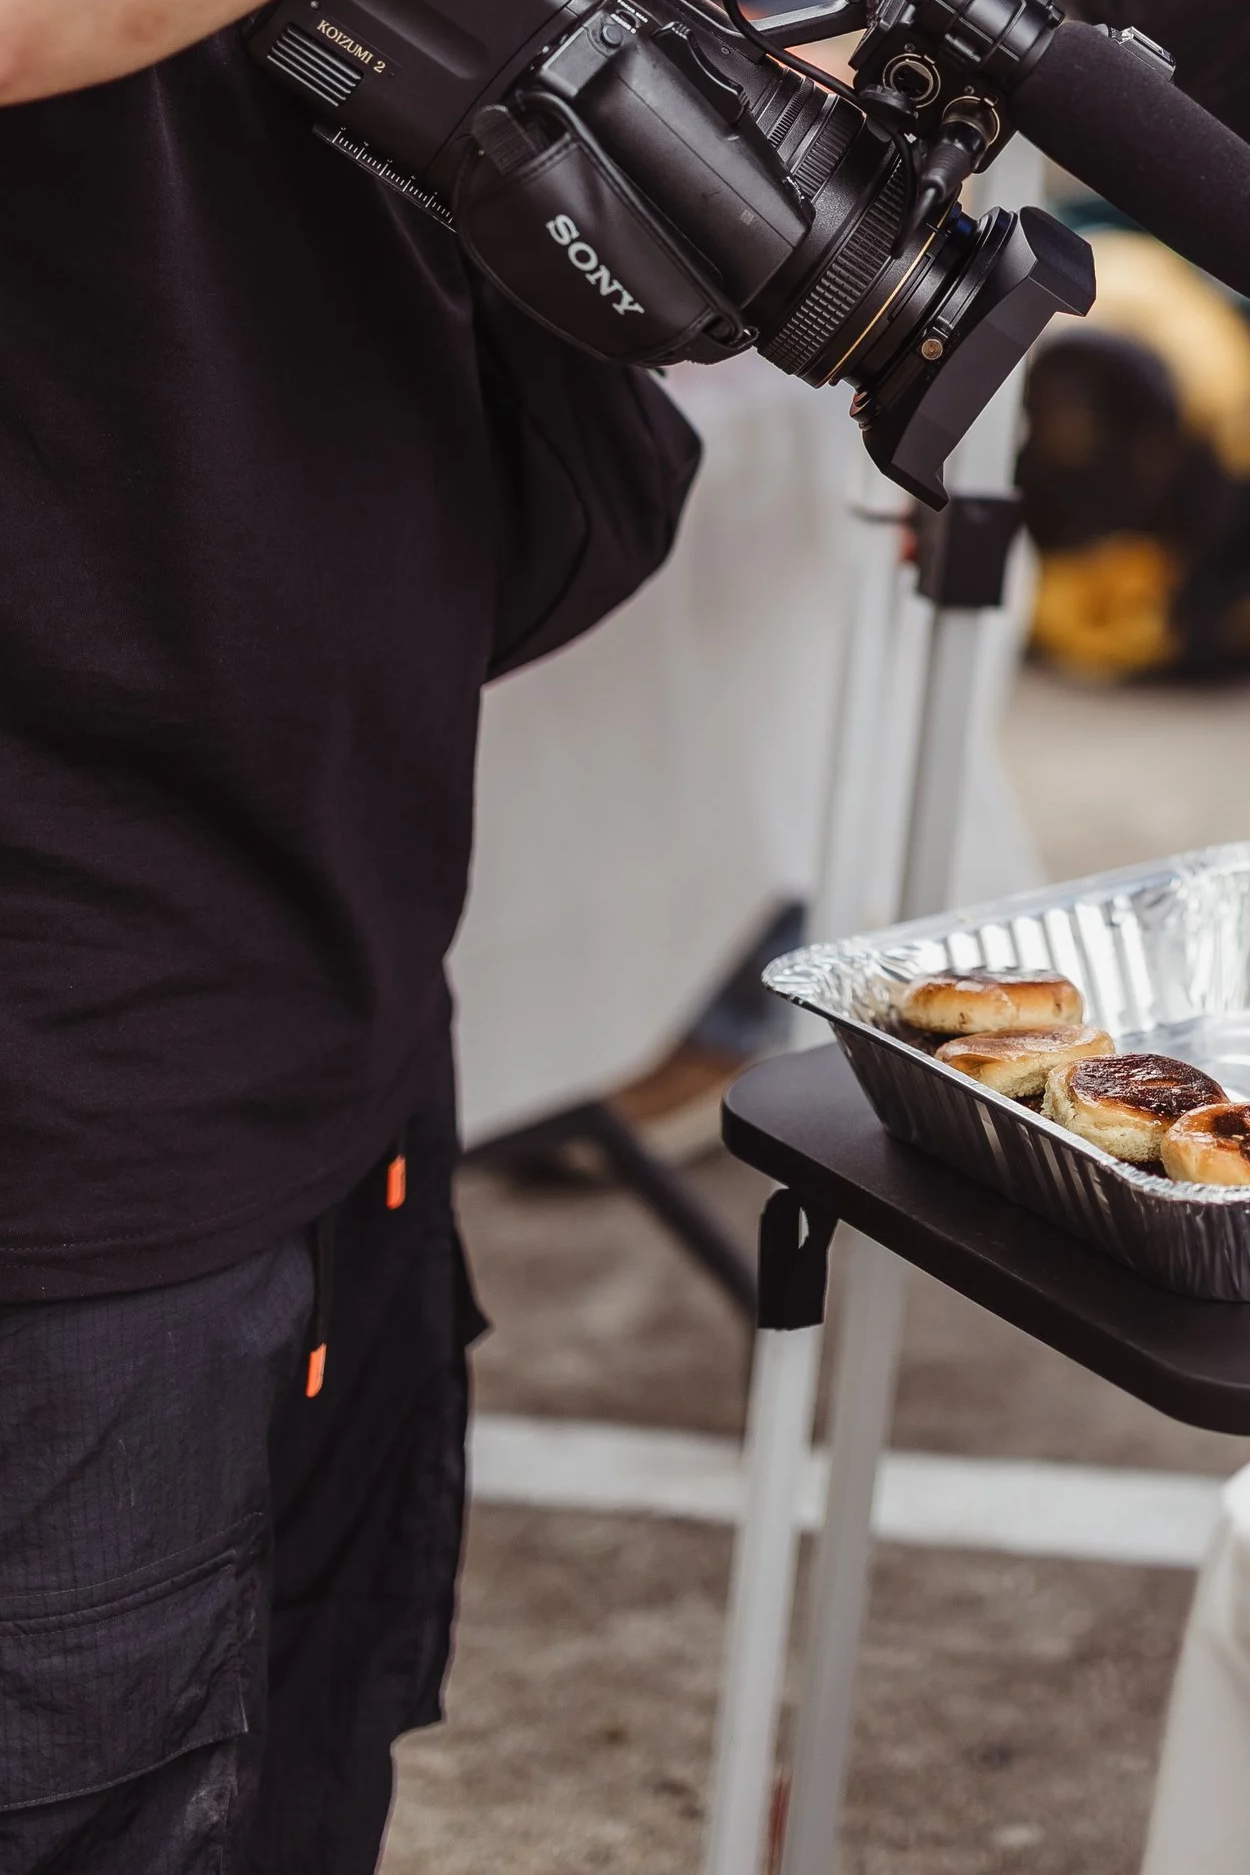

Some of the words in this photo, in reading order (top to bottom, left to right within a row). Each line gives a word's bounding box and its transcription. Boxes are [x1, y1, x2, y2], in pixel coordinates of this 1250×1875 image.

[316, 19, 374, 65] KOIZUMI
[373, 60, 386, 74] 2
[545, 213, 645, 316] SONY
